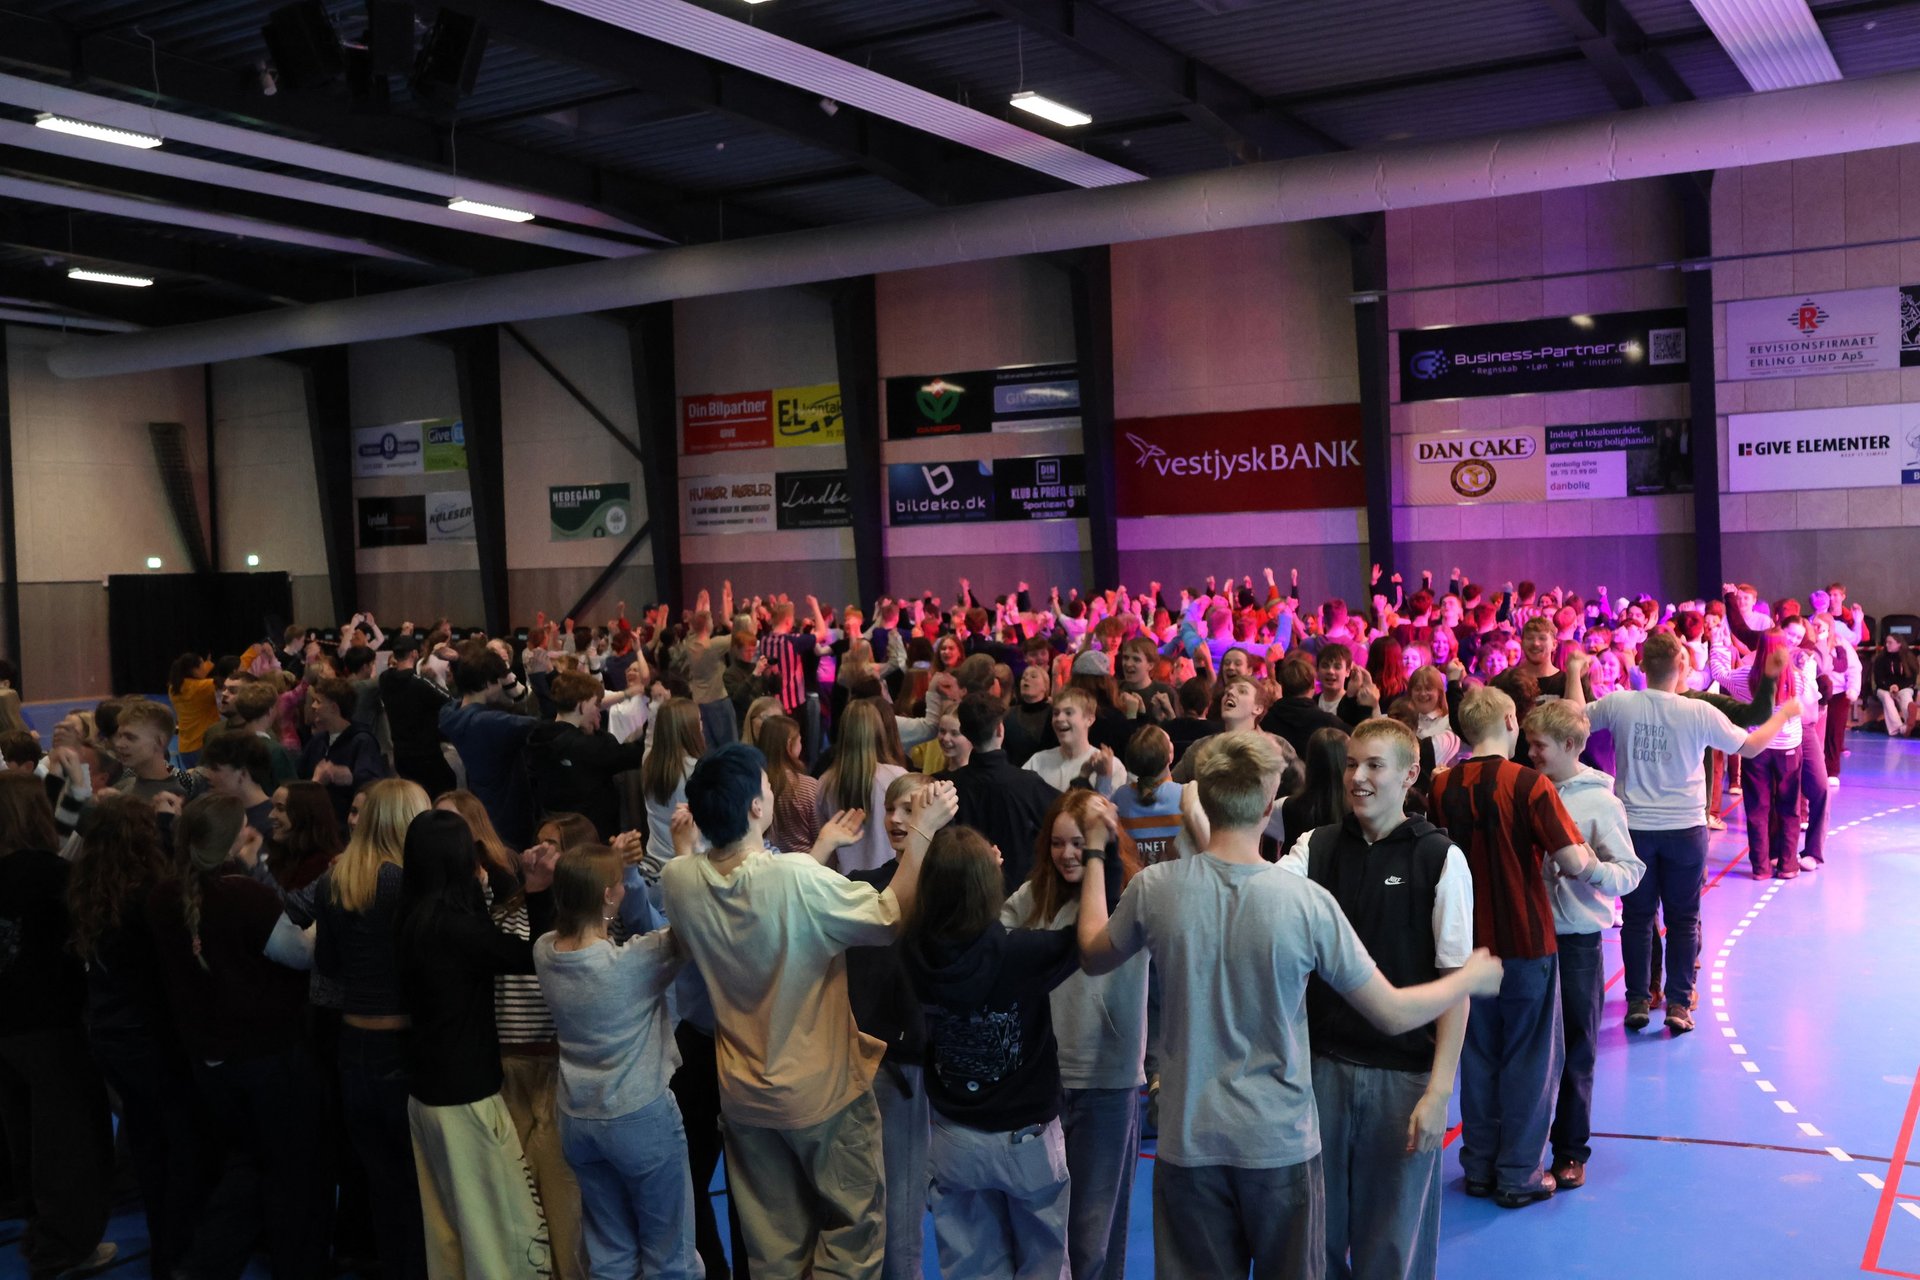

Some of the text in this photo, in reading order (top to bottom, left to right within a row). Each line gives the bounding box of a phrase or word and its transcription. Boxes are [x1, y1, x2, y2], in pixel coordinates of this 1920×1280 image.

[1798, 306, 1819, 330] R
[1454, 340, 1641, 366] Business-Partner.dk
[1750, 335, 1876, 354] REVISIONSFIRMAET
[1476, 357, 1622, 376] Regnskab Løn HR Interim
[1750, 350, 1864, 368] ERLING LUND ApS
[688, 399, 767, 418] Din Bilpartner
[428, 429, 451, 443] Give
[1549, 430, 1579, 440] Indsigt
[1549, 440, 1571, 451] giver
[1585, 439, 1603, 449] tryg
[1604, 435, 1655, 447] bolighandel
[1418, 437, 1529, 460] DAN CAKE
[1755, 435, 1891, 456] GIVE ELEMENTER
[1153, 439, 1361, 481] vestjyskBANK
[1040, 464, 1056, 475] DIN
[1913, 470, 1920, 481] B
[1010, 486, 1032, 500] KLUB
[1040, 484, 1067, 498] PROFIL
[1550, 480, 1590, 491] danbolig
[552, 487, 601, 503] HEDEGÅRD
[896, 497, 987, 513] bildeko.dk
[429, 506, 472, 525] KØLESER
